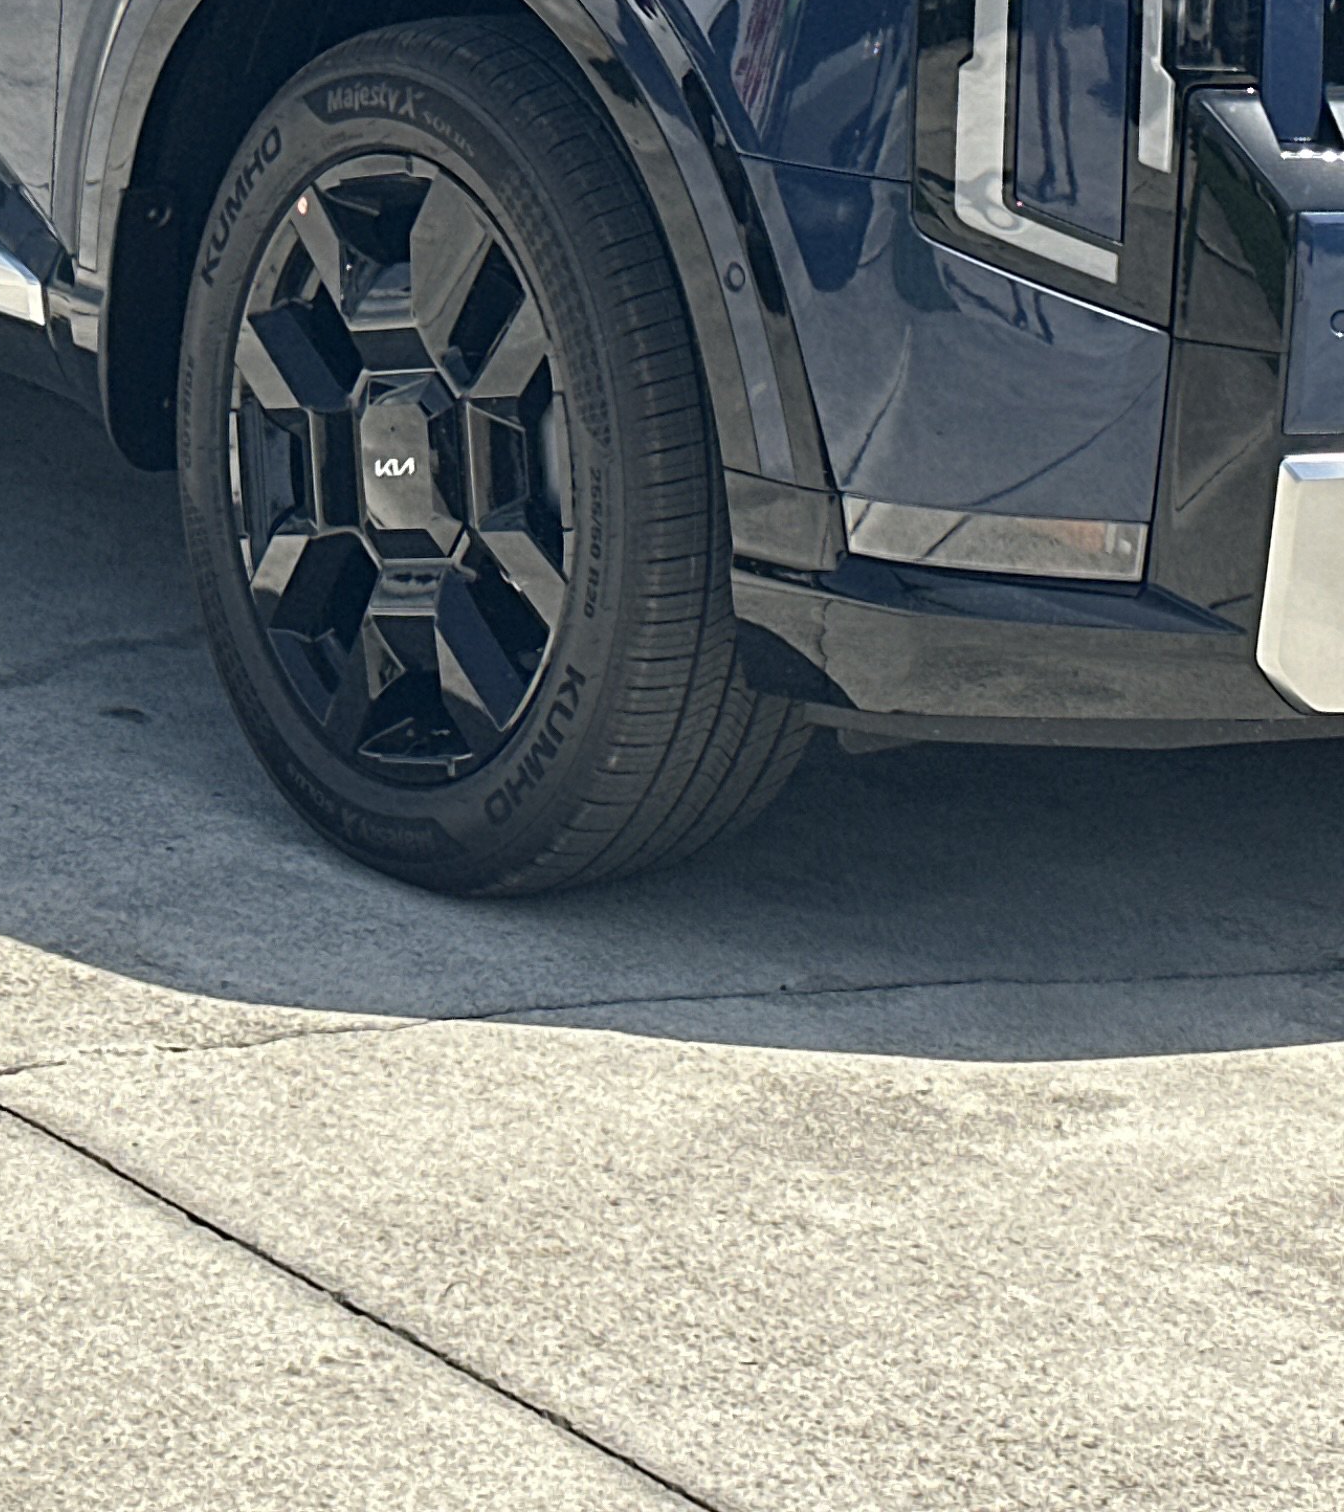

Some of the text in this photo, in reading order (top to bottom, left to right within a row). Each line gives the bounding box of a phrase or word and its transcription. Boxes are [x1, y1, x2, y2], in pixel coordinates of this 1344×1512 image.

[201, 125, 282, 286] KUMHO
[374, 456, 415, 477] KIA
[484, 663, 586, 825] KUMHO
